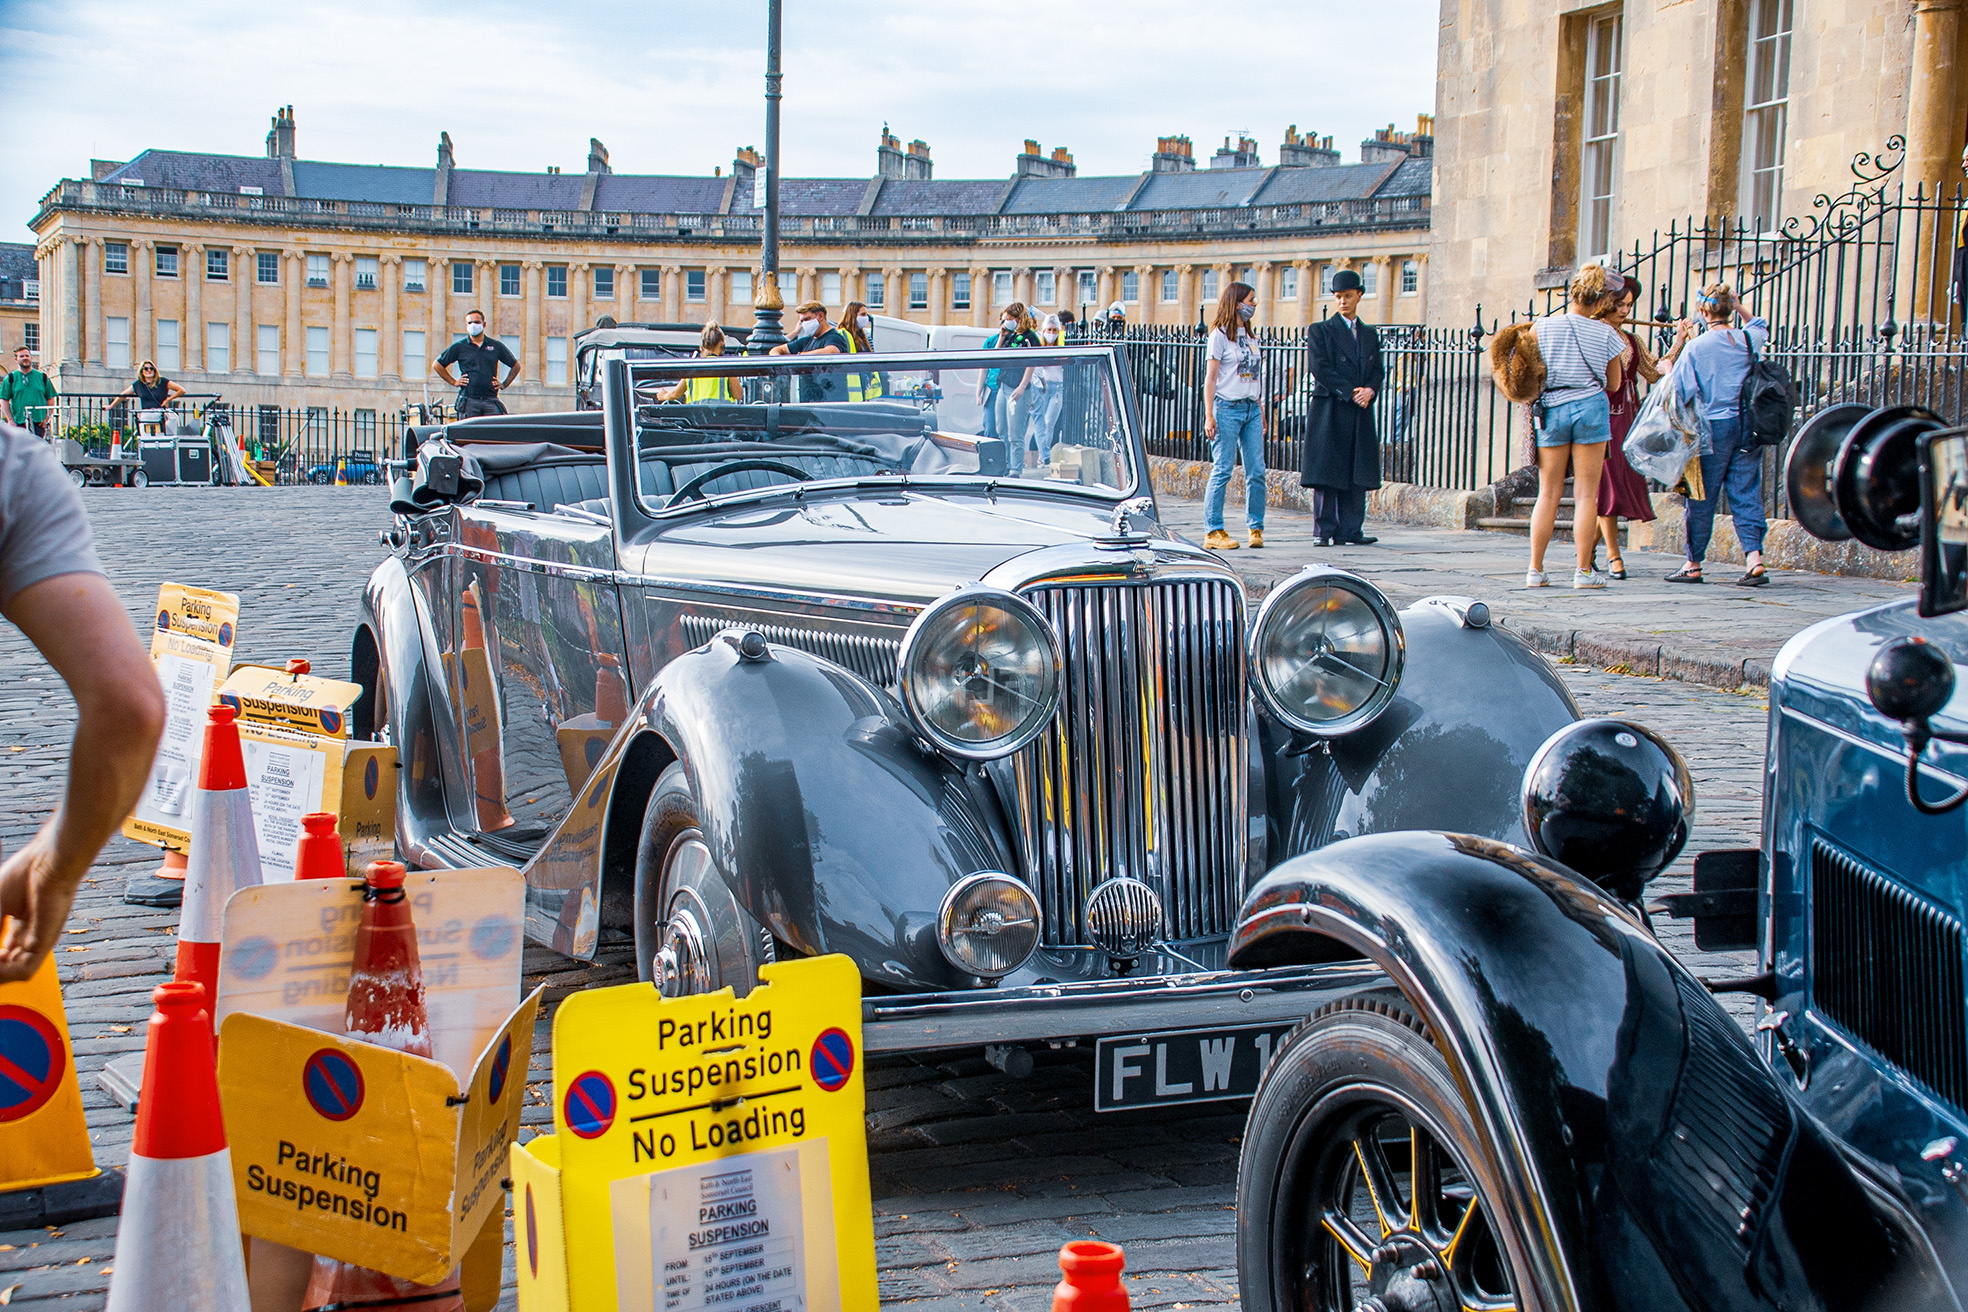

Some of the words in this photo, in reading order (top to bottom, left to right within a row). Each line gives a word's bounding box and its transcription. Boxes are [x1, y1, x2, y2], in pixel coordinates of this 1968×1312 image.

[181, 597, 212, 620] Parking
[171, 612, 218, 635] Suspension
[168, 637, 178, 650] No
[262, 681, 315, 702] Parking
[243, 696, 318, 717] Suspension
[261, 775, 295, 787] SUSPENSION
[267, 765, 290, 776] PARKING
[356, 821, 380, 840] Parking
[658, 1008, 772, 1050] Parking
[627, 1048, 801, 1101] Suspension
[1113, 1037, 1236, 1100] FLW
[633, 1128, 675, 1163] No
[691, 1106, 806, 1151] Loading
[473, 1119, 508, 1179] Parking
[277, 1140, 381, 1198] Parking
[247, 1164, 408, 1232] Suspension
[700, 1199, 757, 1222] PARKING
[688, 1218, 769, 1246] SUSPENSION
[719, 1244, 764, 1260] SEPTEMBER
[720, 1258, 765, 1275] SEPTEMBER
[682, 1287, 690, 1295] OF
[704, 1284, 714, 1294] 24
[715, 1277, 741, 1291] HOURS
[742, 1274, 756, 1287] (ON
[757, 1271, 772, 1284] THE
[773, 1266, 792, 1279] DATE
[705, 1290, 735, 1304] STATED
[736, 1285, 764, 1298] ABOVE)
[745, 1300, 782, 1312] CRESCENT
